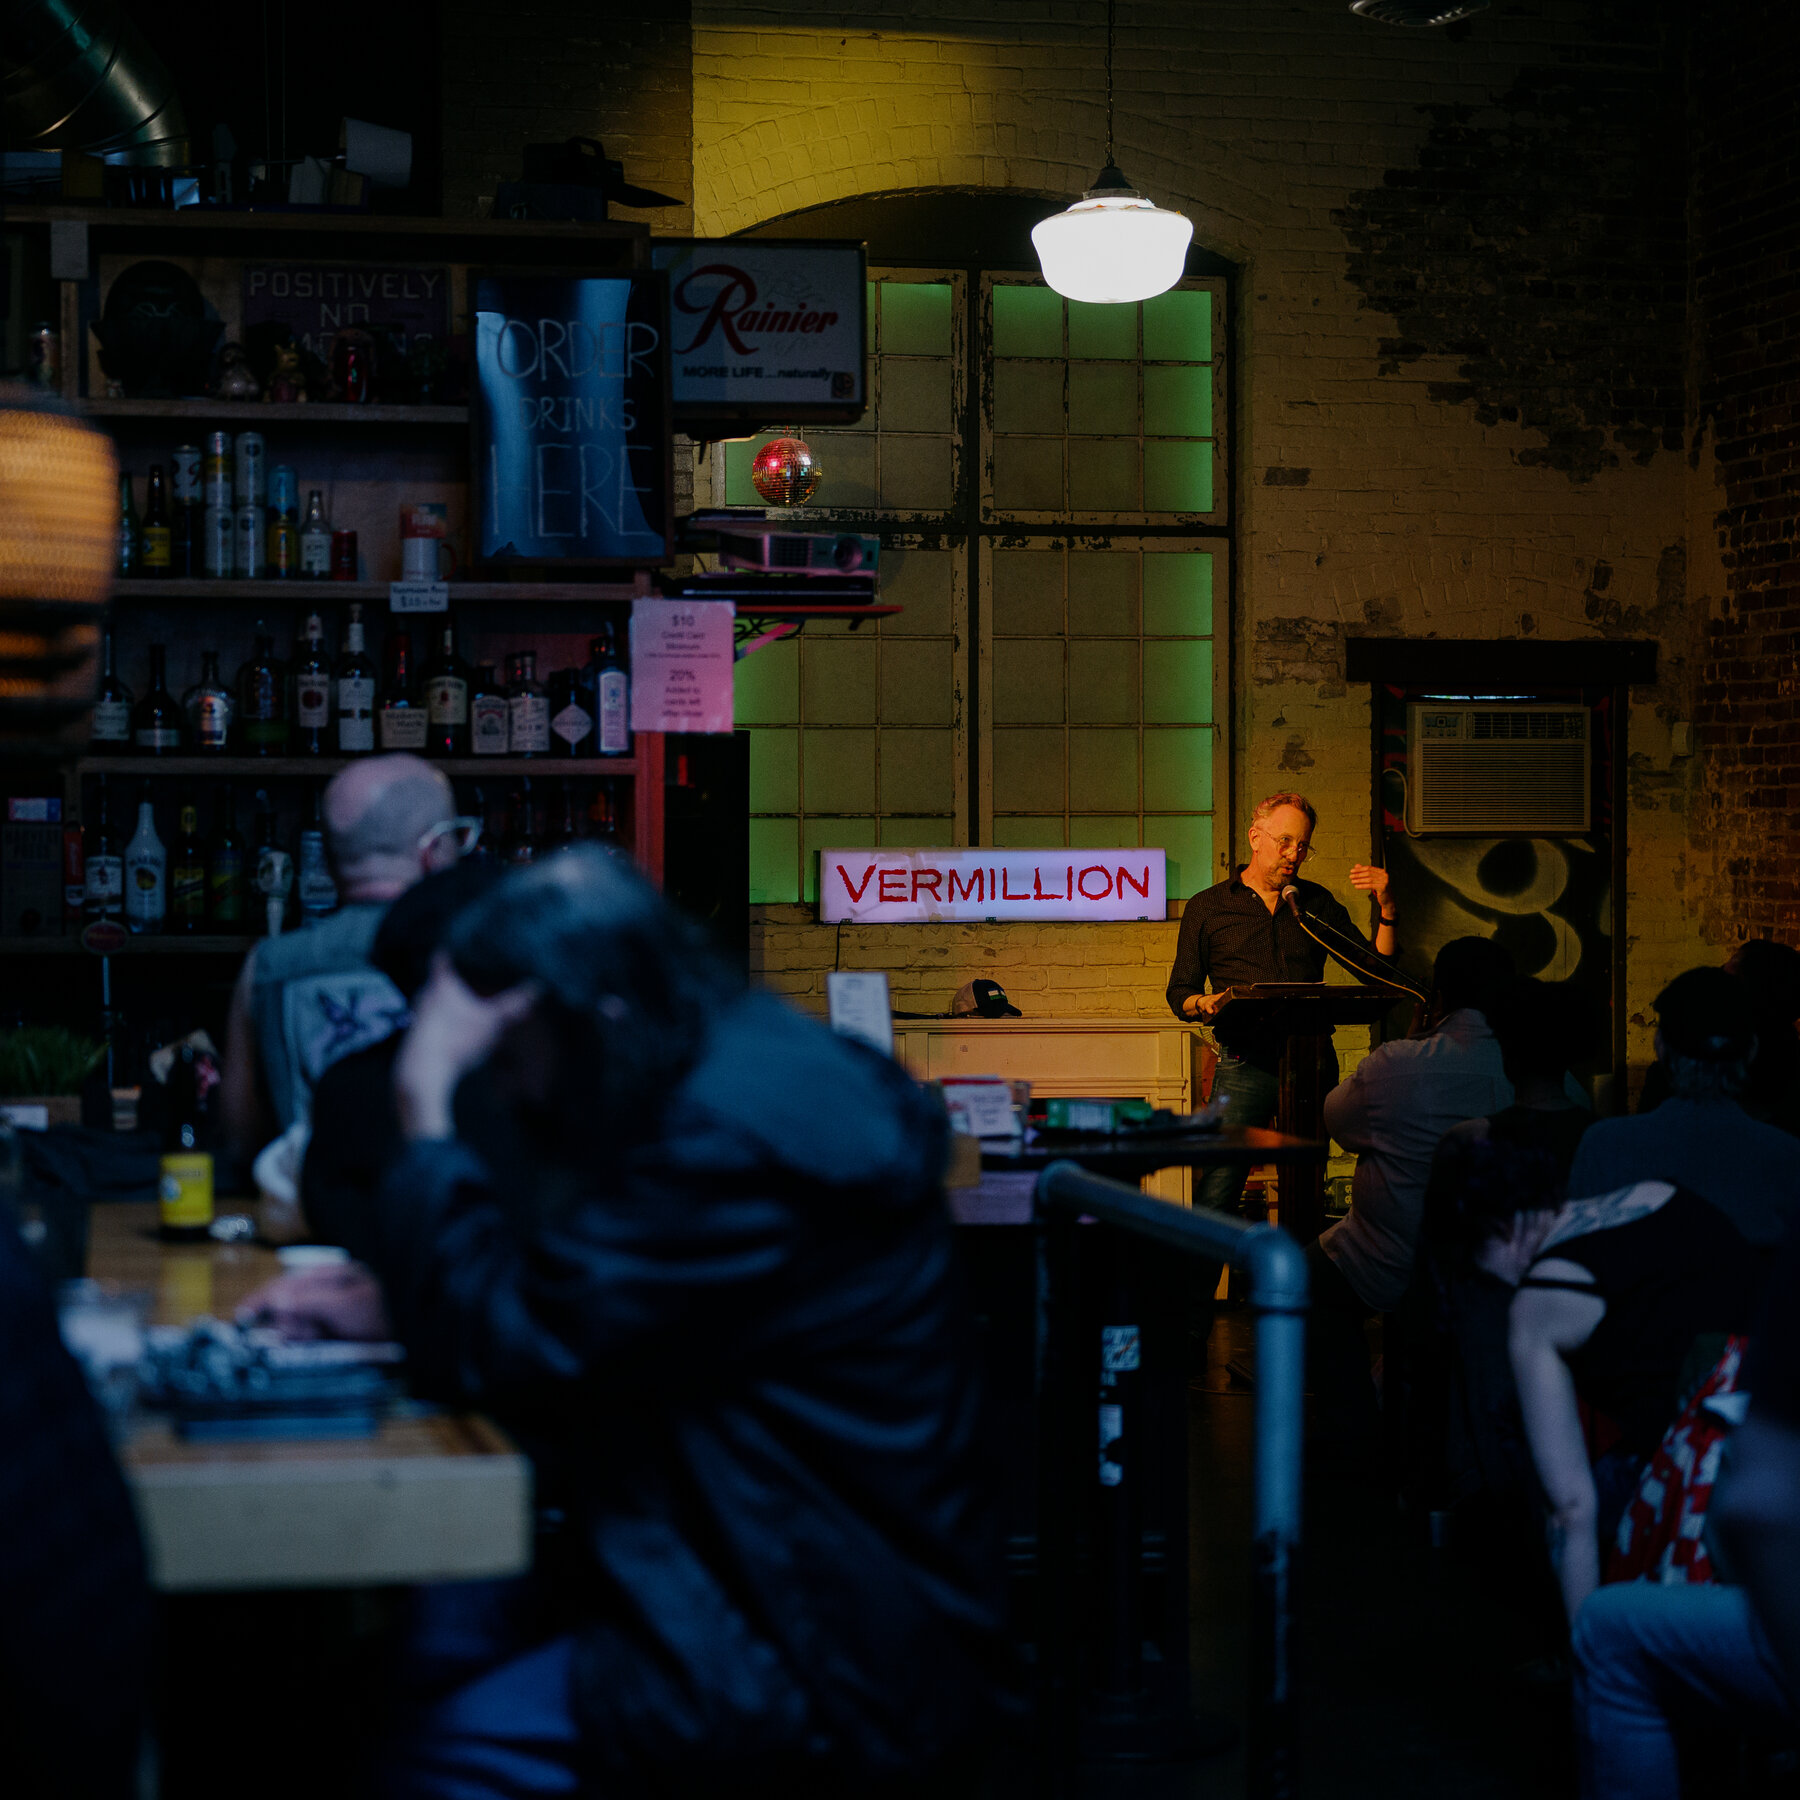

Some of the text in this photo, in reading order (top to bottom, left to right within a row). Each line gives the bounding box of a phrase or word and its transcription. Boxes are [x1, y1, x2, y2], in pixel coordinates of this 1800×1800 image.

[250, 271, 440, 300] POSITIVELY
[320, 302, 370, 328] NO
[674, 264, 839, 355] Rainier
[497, 318, 660, 381] ORDER
[683, 366, 728, 378] MORE
[519, 397, 638, 432] DRINKS
[490, 443, 653, 538] HERE
[671, 614, 695, 627] $10
[670, 669, 695, 681] 20%
[836, 863, 1150, 904] VERMILLION
